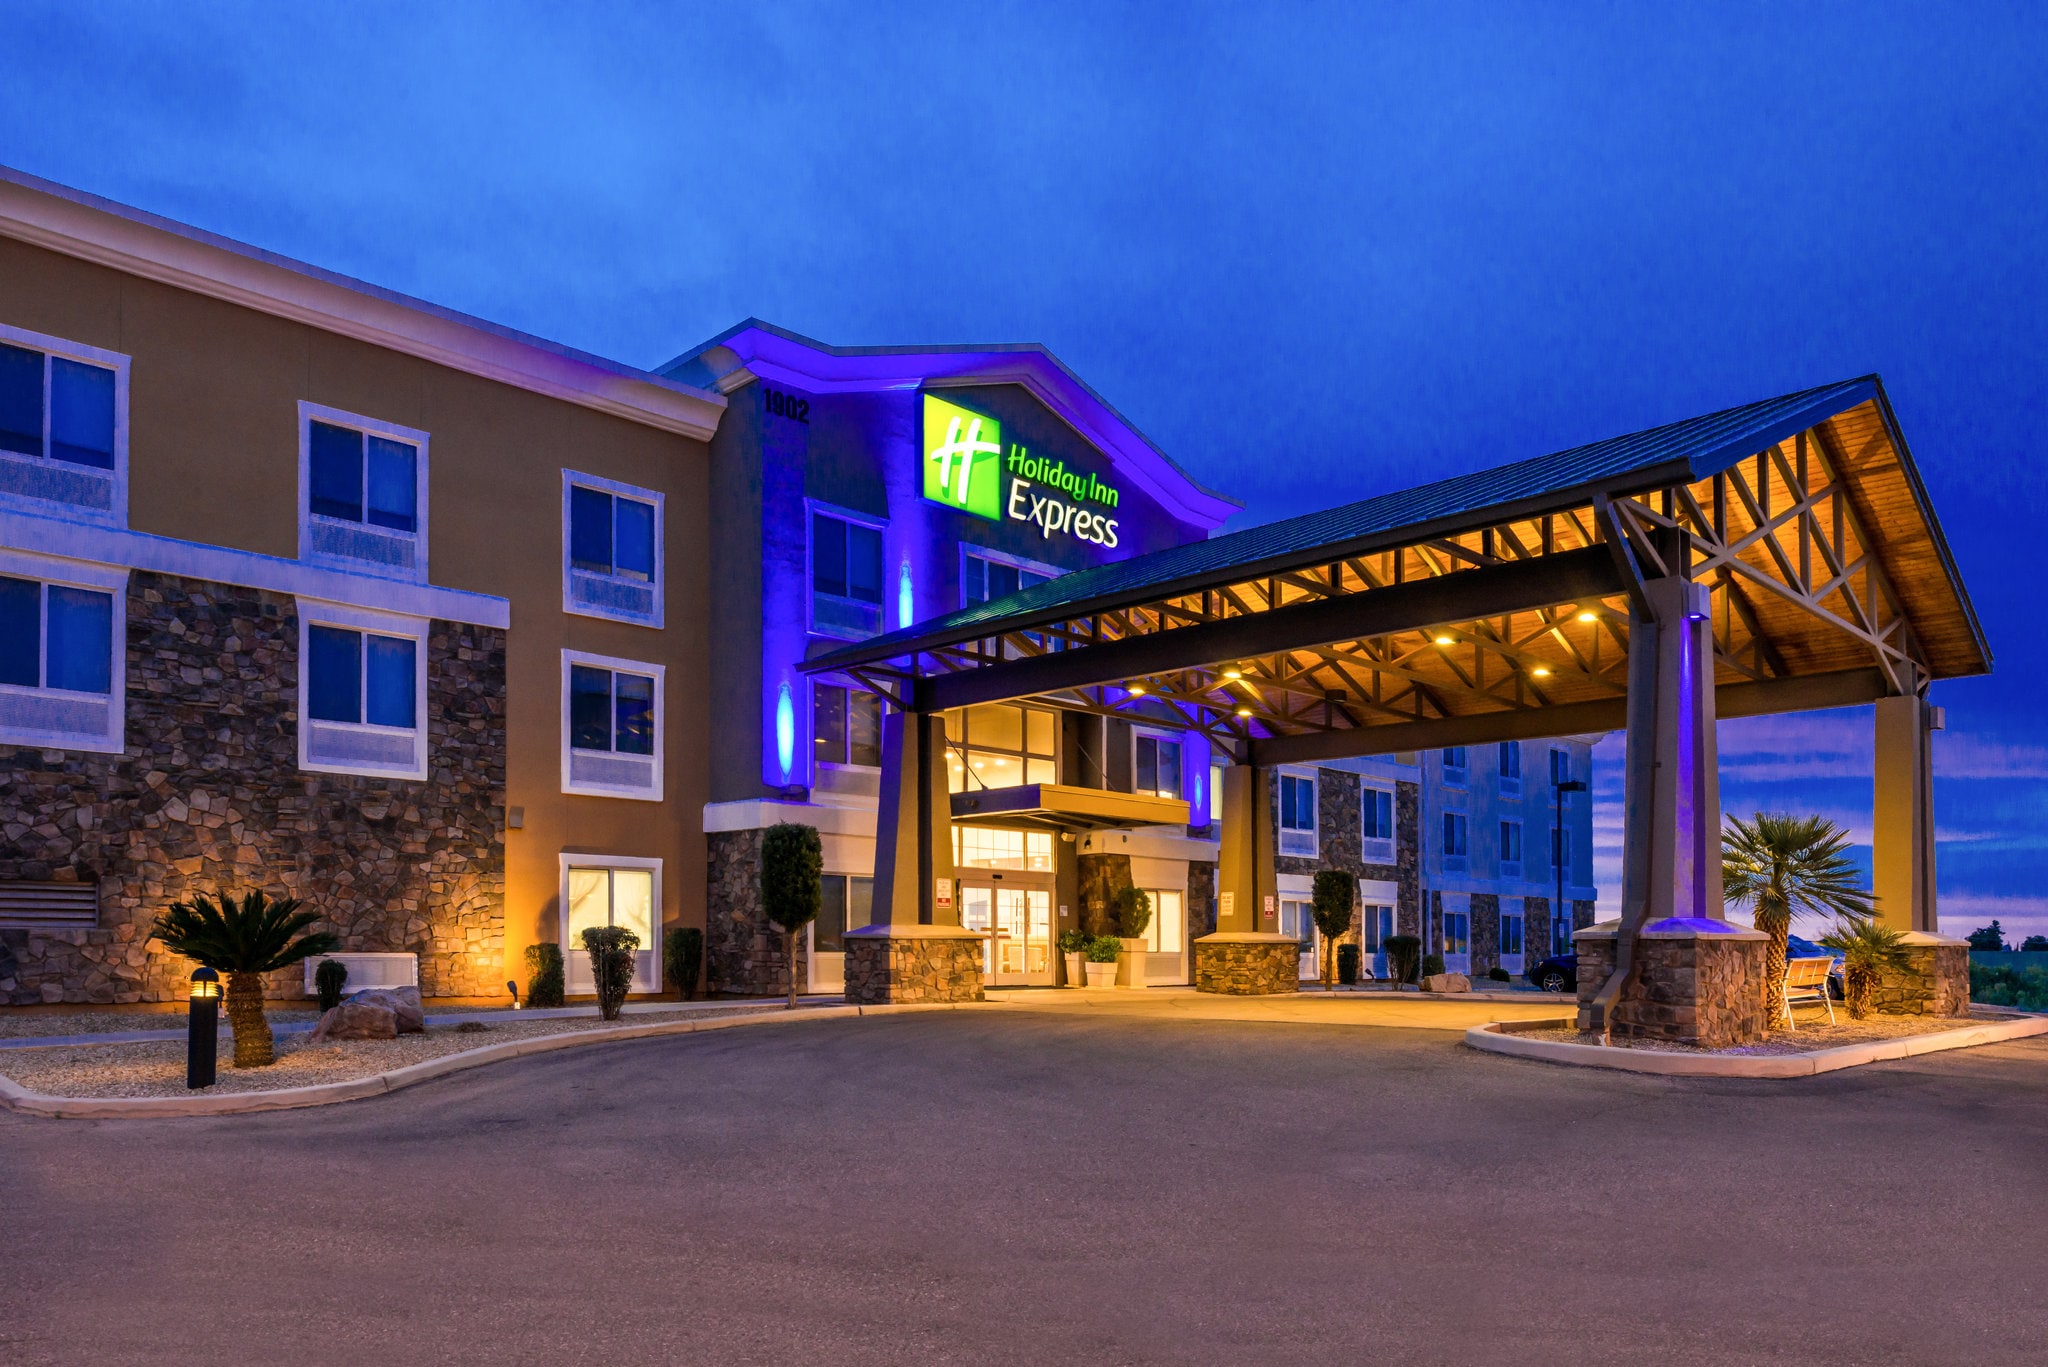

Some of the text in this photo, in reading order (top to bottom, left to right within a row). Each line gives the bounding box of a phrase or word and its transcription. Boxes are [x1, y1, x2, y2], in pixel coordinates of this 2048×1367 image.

[764, 388, 809, 425] 1902
[1008, 443, 1119, 508] Holiday Inn
[1008, 477, 1119, 548] Express
